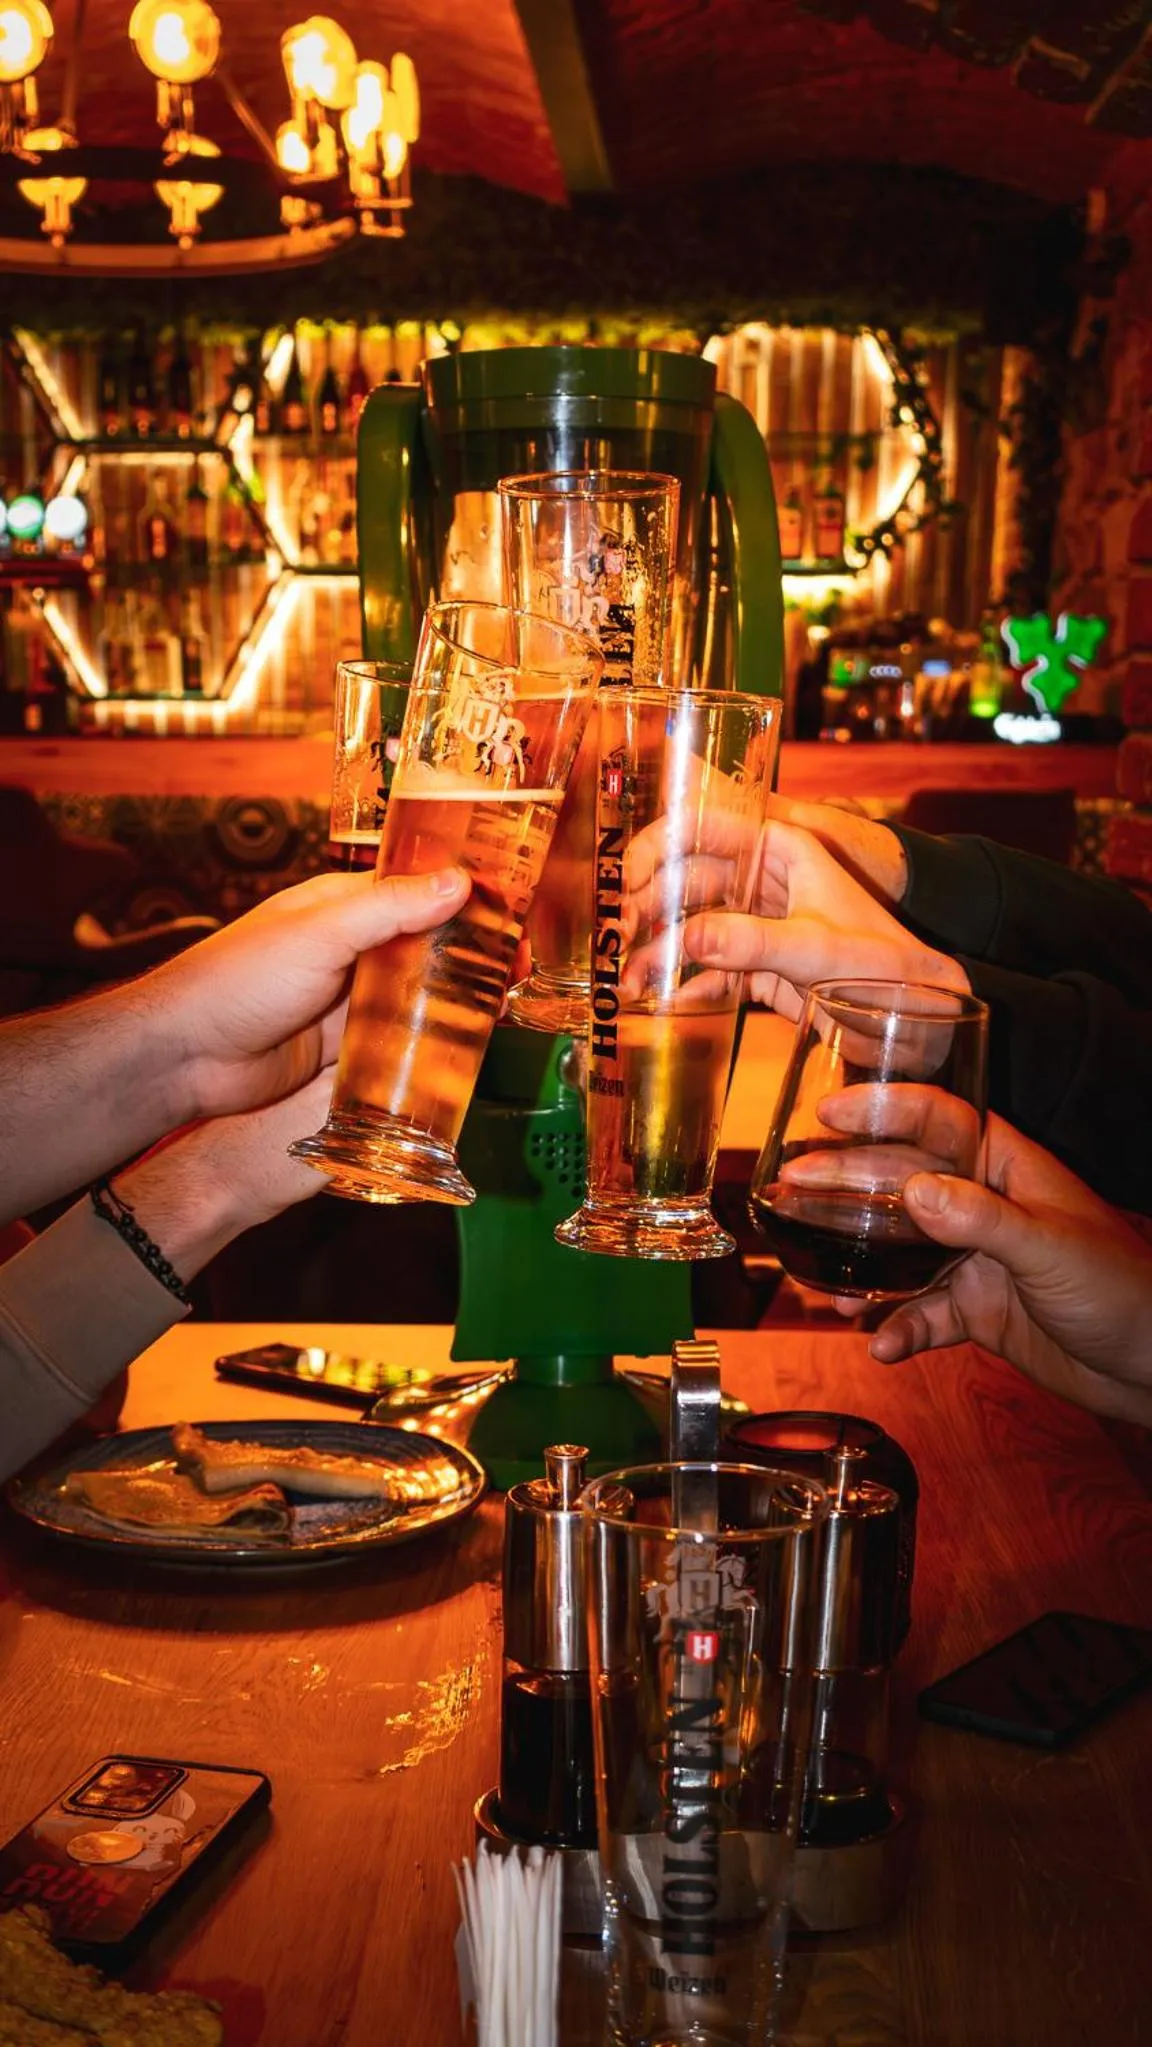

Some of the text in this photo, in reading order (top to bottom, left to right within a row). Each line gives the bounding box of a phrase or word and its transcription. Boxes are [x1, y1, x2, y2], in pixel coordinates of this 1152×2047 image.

[592, 826, 624, 1060] HOLSTEN
[692, 1635, 714, 1660] H
[661, 1697, 724, 1956] HOLSTEN
